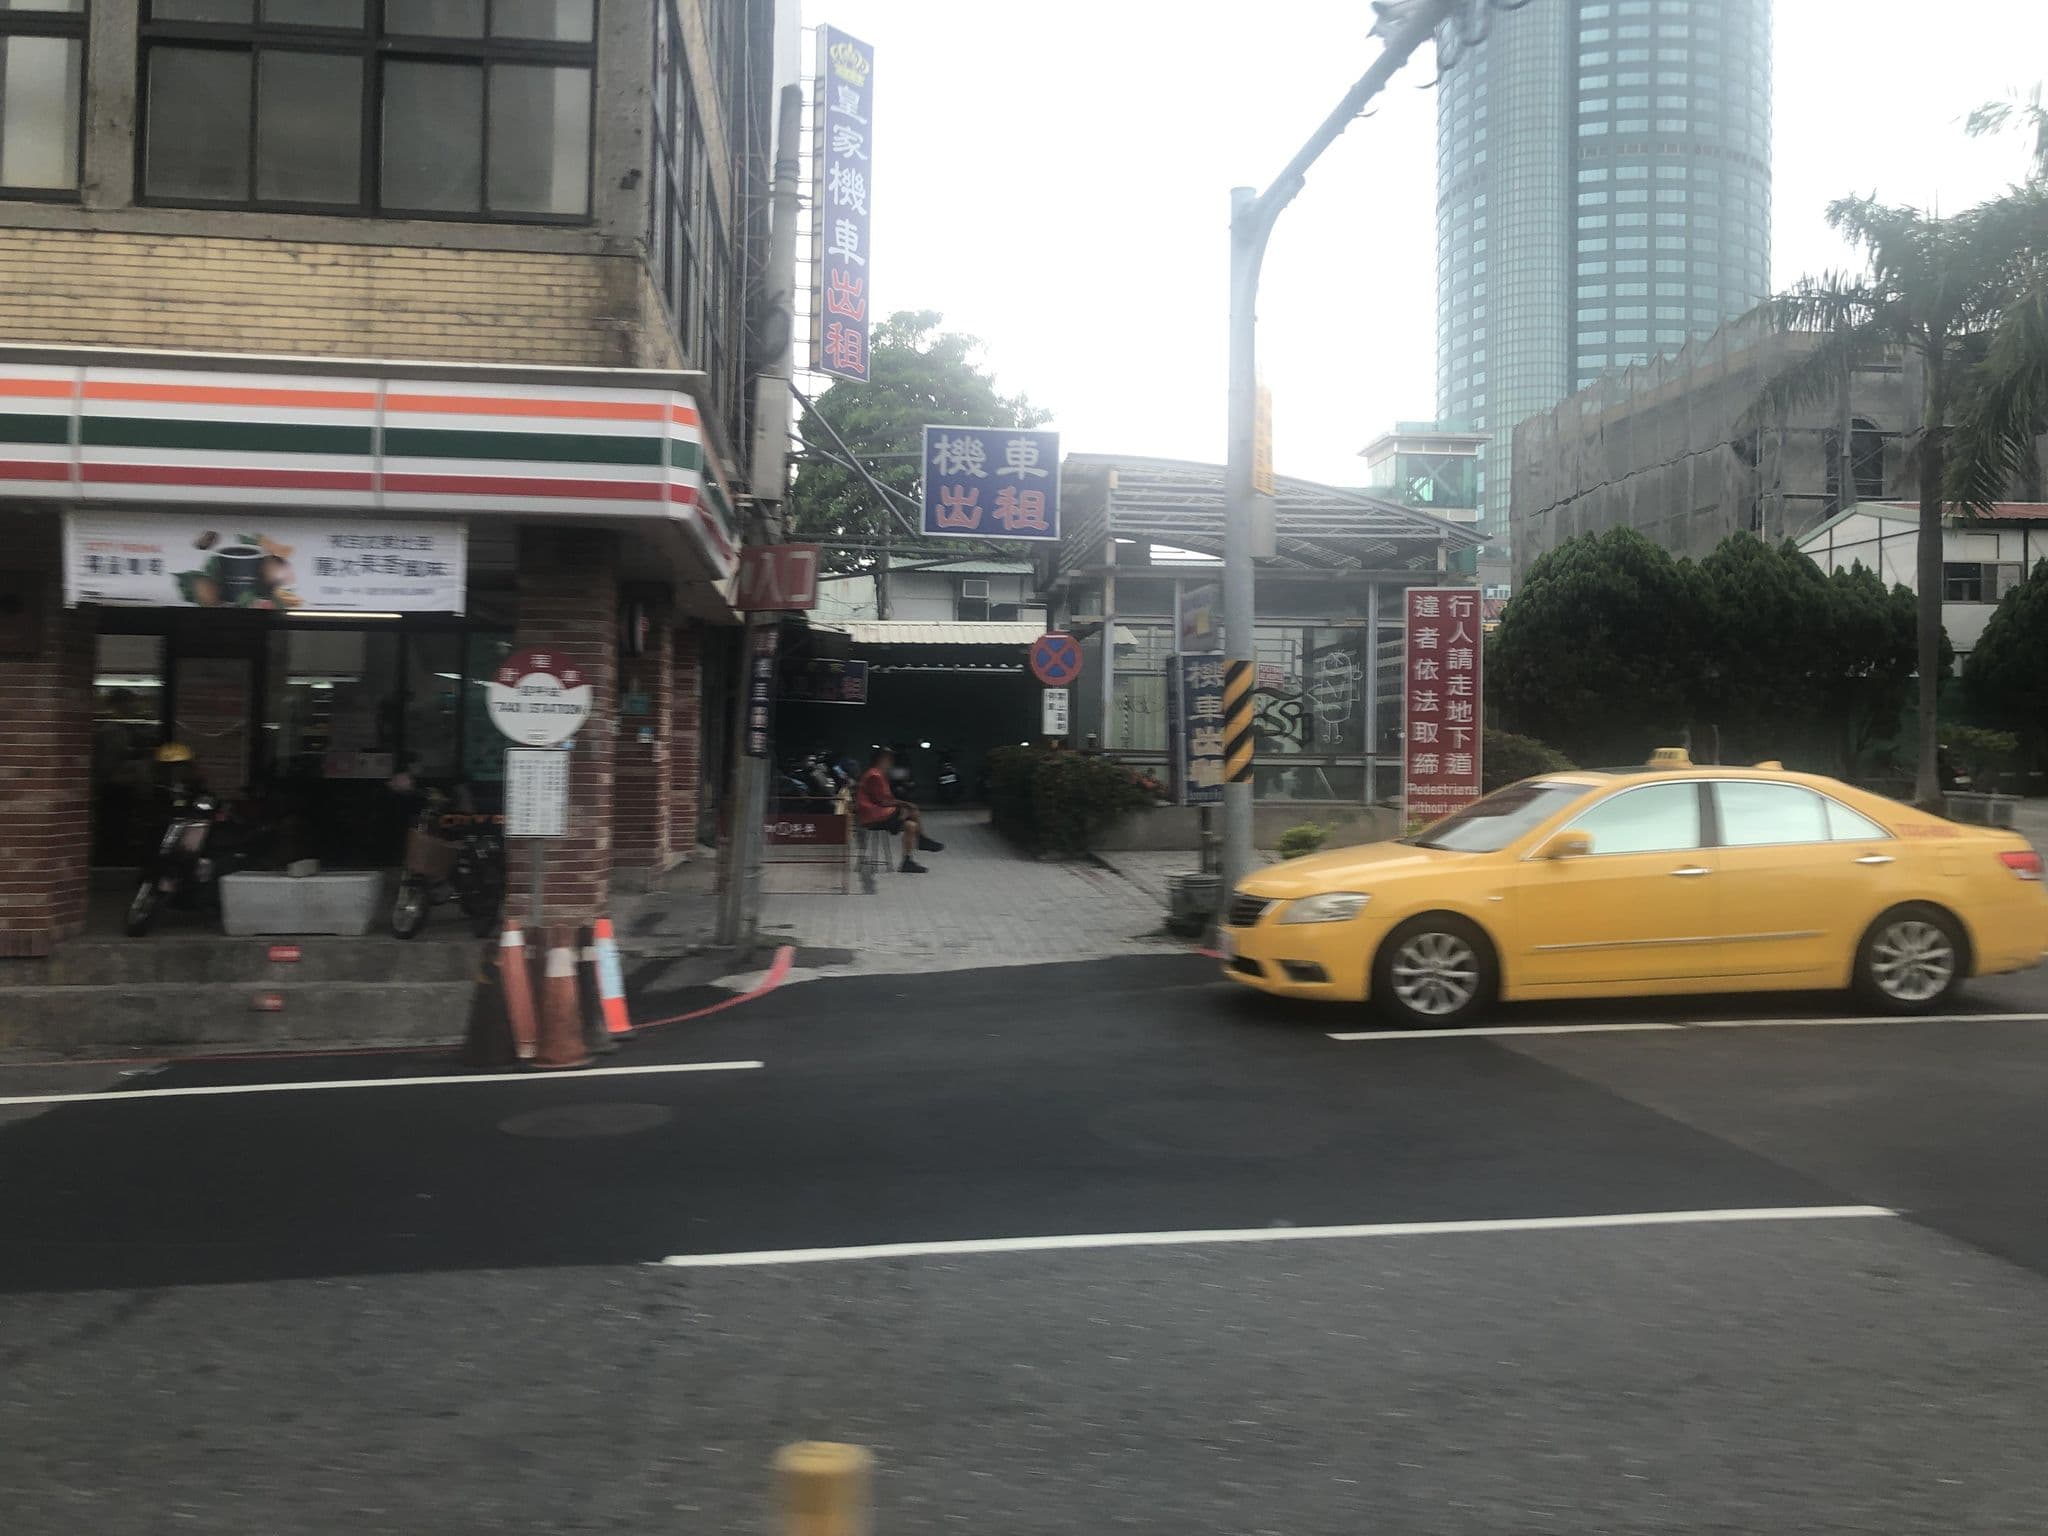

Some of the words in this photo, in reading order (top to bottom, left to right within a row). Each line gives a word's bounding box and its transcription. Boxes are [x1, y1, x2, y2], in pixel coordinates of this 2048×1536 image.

[826, 85, 869, 375] 皇家機車出租
[932, 433, 1050, 481] 機車
[934, 483, 1050, 532] 出租
[1412, 595, 1441, 775] 違者依法取締
[1445, 595, 1474, 775] 行人請走地下道
[1408, 782, 1480, 797] Pedestrians
[1409, 801, 1450, 815] without
